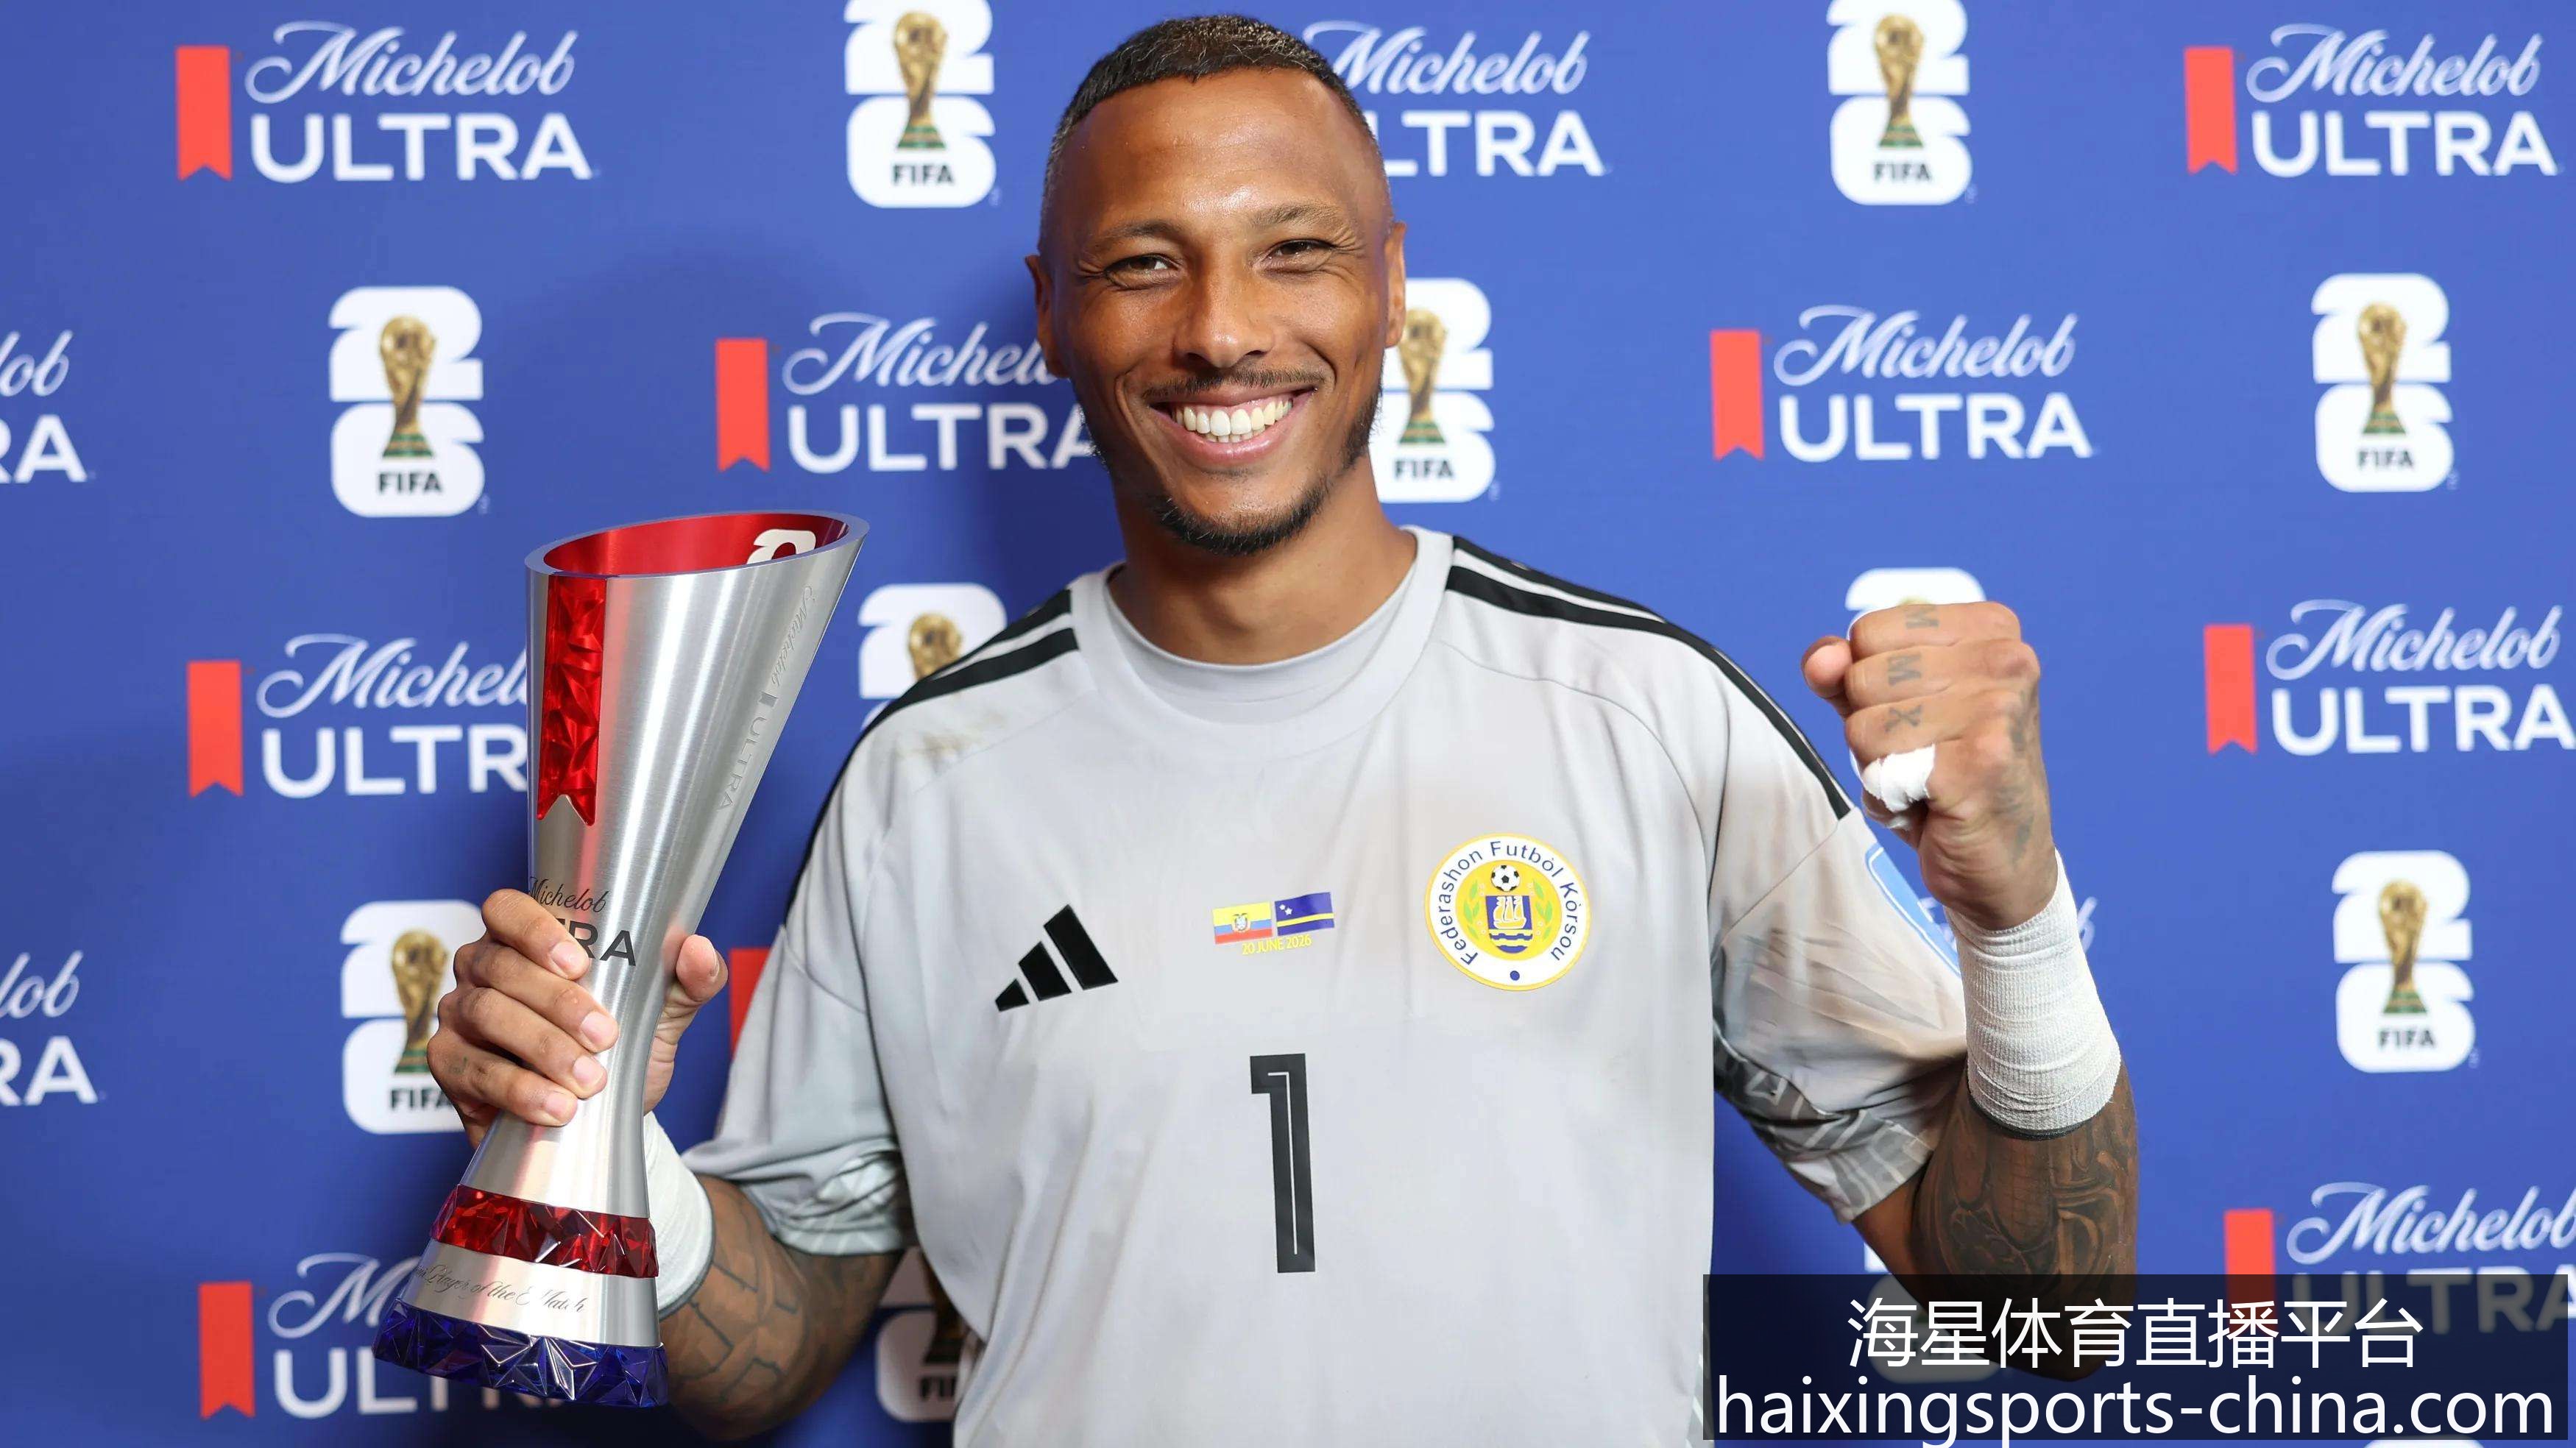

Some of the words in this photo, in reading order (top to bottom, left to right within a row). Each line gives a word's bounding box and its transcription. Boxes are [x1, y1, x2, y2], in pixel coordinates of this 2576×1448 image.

[245, 21, 578, 104] Michelob
[1302, 20, 1591, 95] Michelob
[2246, 24, 2543, 103] Michelob
[251, 113, 592, 183] ULTRA
[893, 164, 955, 185] FIFA
[1363, 110, 1605, 177] LTRA
[1873, 161, 1932, 182] FIFA
[2251, 110, 2557, 177] ULTRA
[782, 312, 1058, 395] Michel
[1773, 304, 2078, 386] Michelob
[1780, 392, 2092, 462] ULTRA
[2357, 449, 2415, 469] FIFA
[378, 472, 443, 494] FIFA
[1394, 458, 1454, 479] FIFA
[2265, 599, 2563, 680] Michelob
[257, 634, 526, 718] Michel
[2271, 684, 2576, 756] ULTRA
[262, 725, 526, 798] ULTR
[1439, 849, 1484, 965] Federashon
[1242, 943, 1254, 955] 20
[1256, 938, 1284, 954] JUNE
[1287, 934, 1312, 949] 2026
[2379, 1028, 2436, 1048] FIFA
[1250, 1053, 1315, 1273] 1
